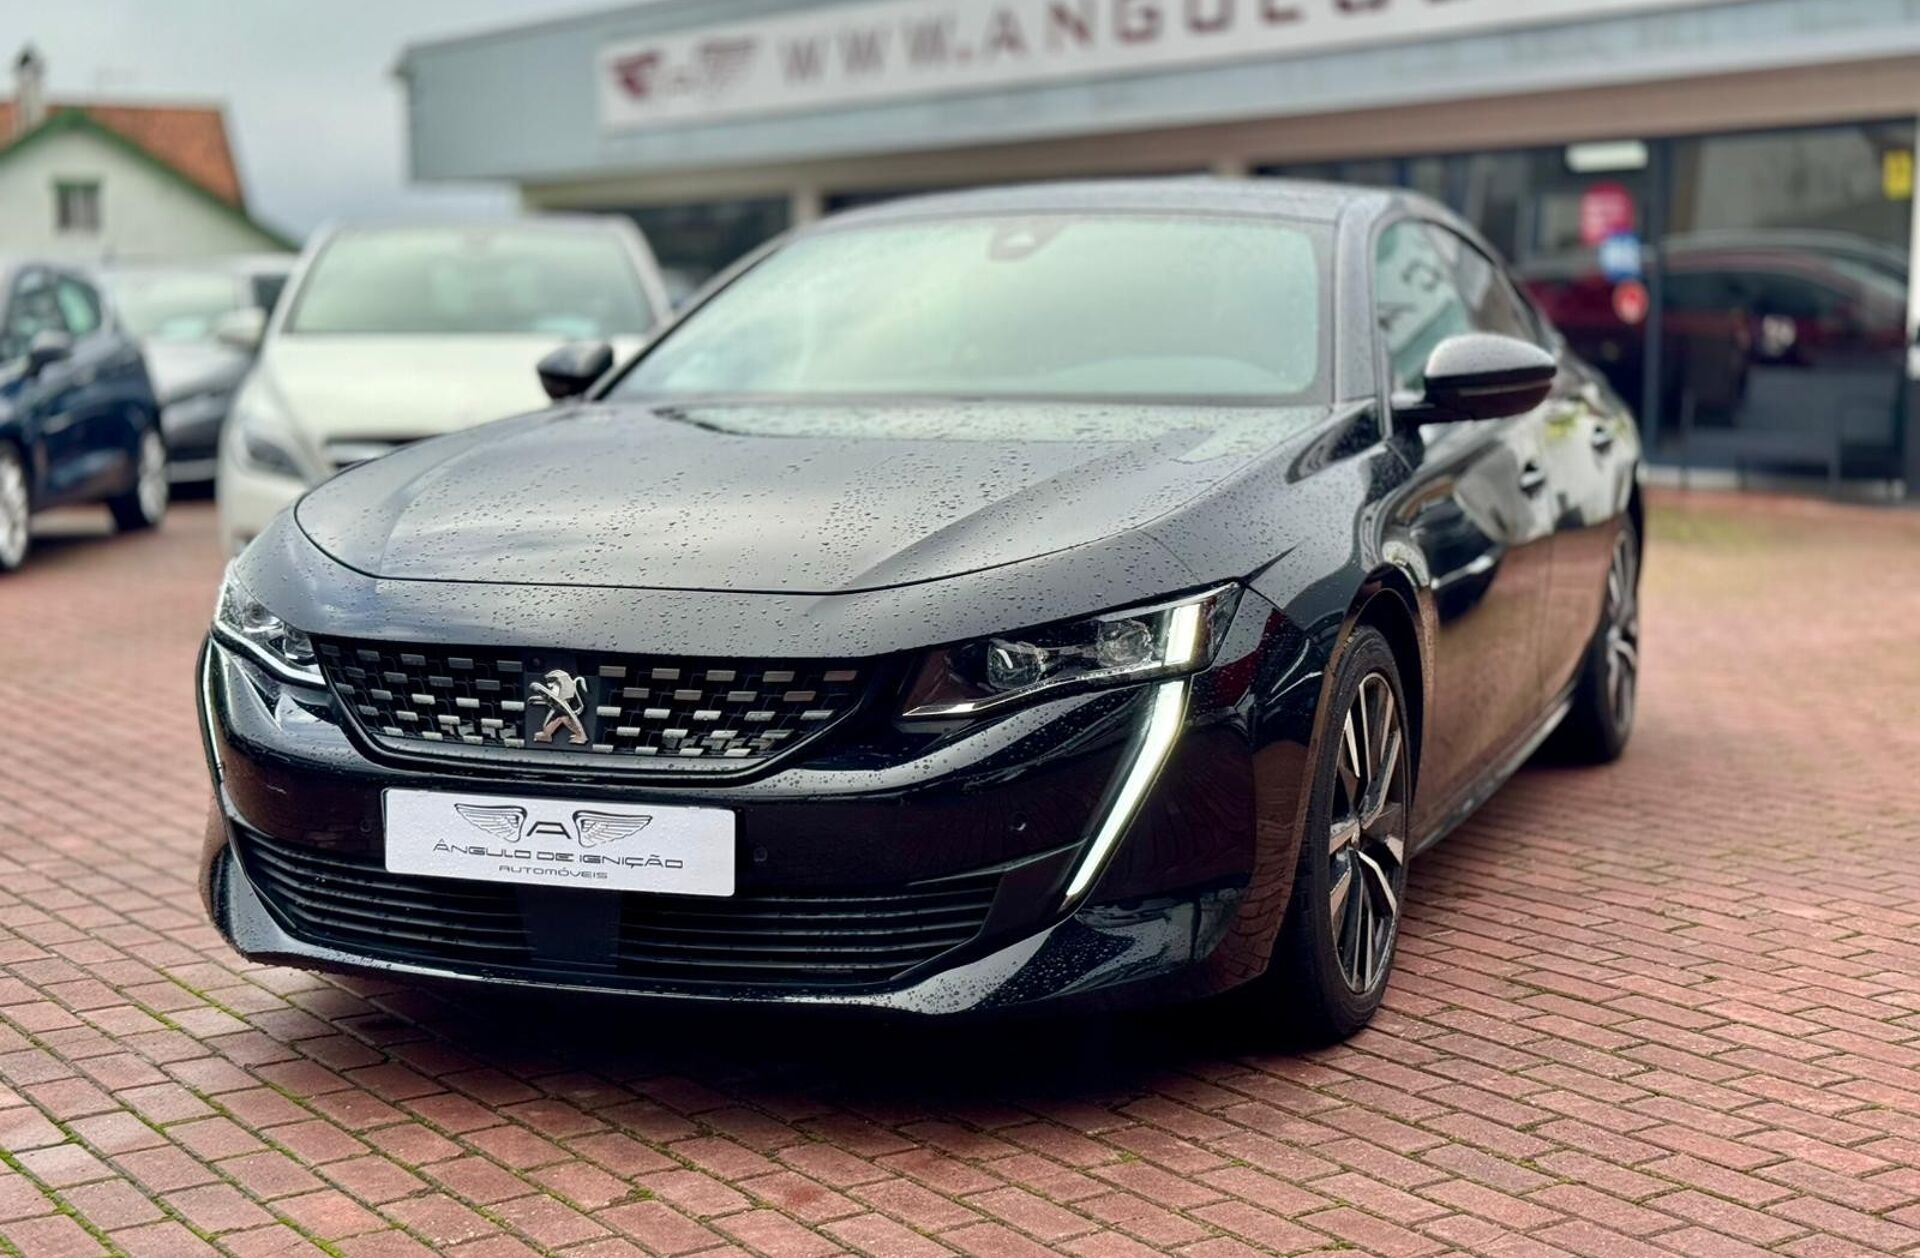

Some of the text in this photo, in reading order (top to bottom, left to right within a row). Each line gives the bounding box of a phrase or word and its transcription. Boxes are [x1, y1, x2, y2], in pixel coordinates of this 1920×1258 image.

[526, 821, 572, 840] A
[432, 838, 684, 869] ÂNGULO DE IGNIÇÃO
[498, 864, 608, 879] AUTOMÓVEIS
